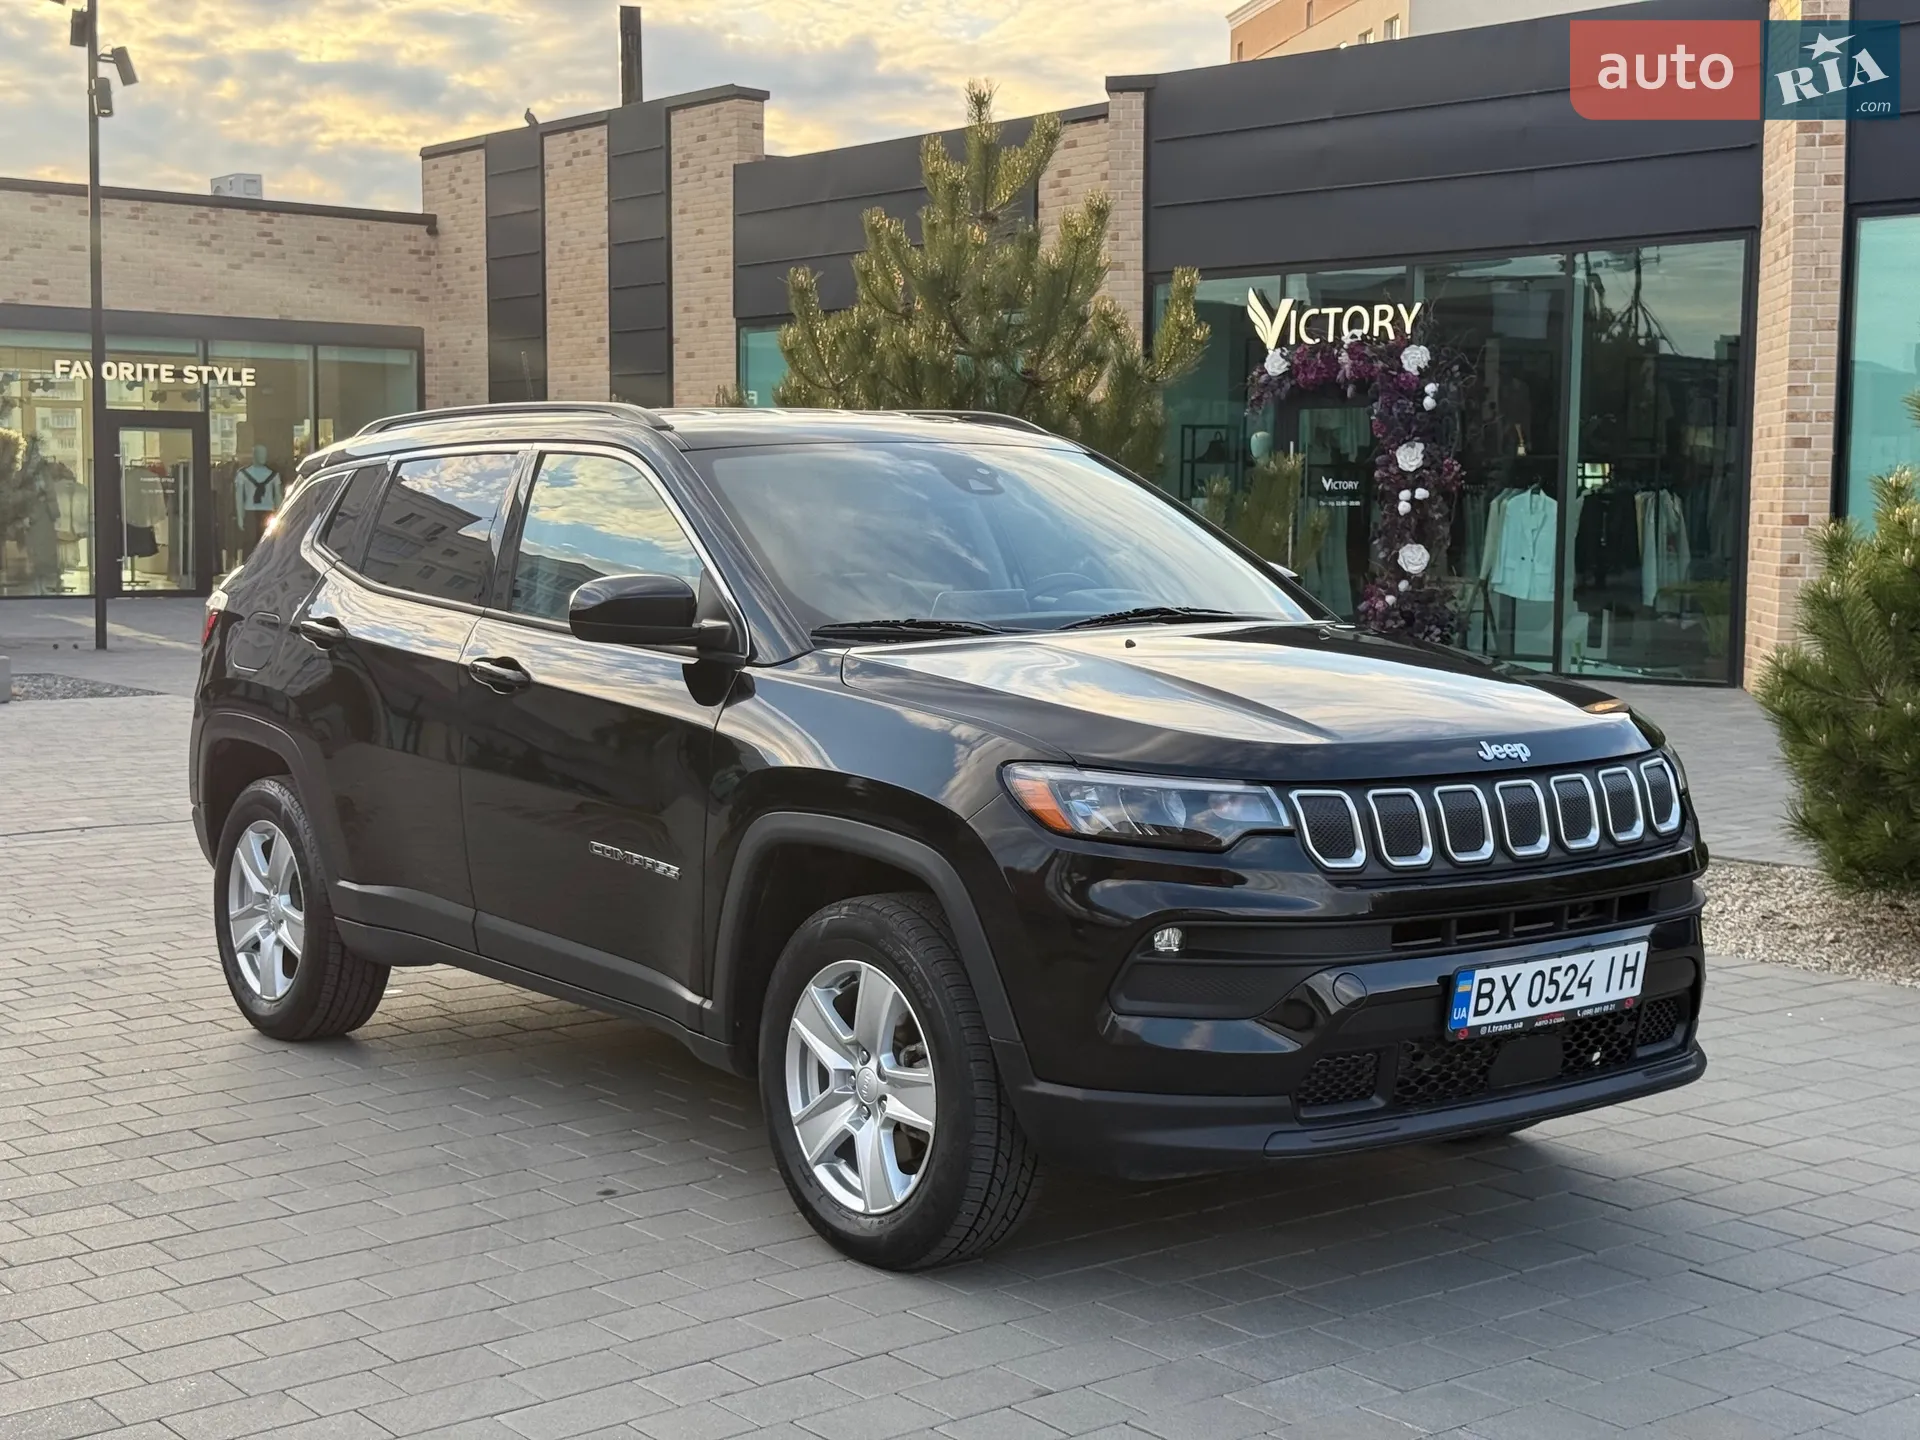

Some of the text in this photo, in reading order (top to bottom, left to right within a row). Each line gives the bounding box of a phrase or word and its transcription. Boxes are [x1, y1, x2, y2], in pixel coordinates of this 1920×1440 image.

[1247, 287, 1422, 354] VICTORY
[183, 365, 256, 386] STYLE
[1321, 475, 1360, 491] VICTORY
[1478, 741, 1531, 762] Jeep
[1473, 951, 1641, 1017] BX 0524 IH
[1453, 1009, 1467, 1020] UA
